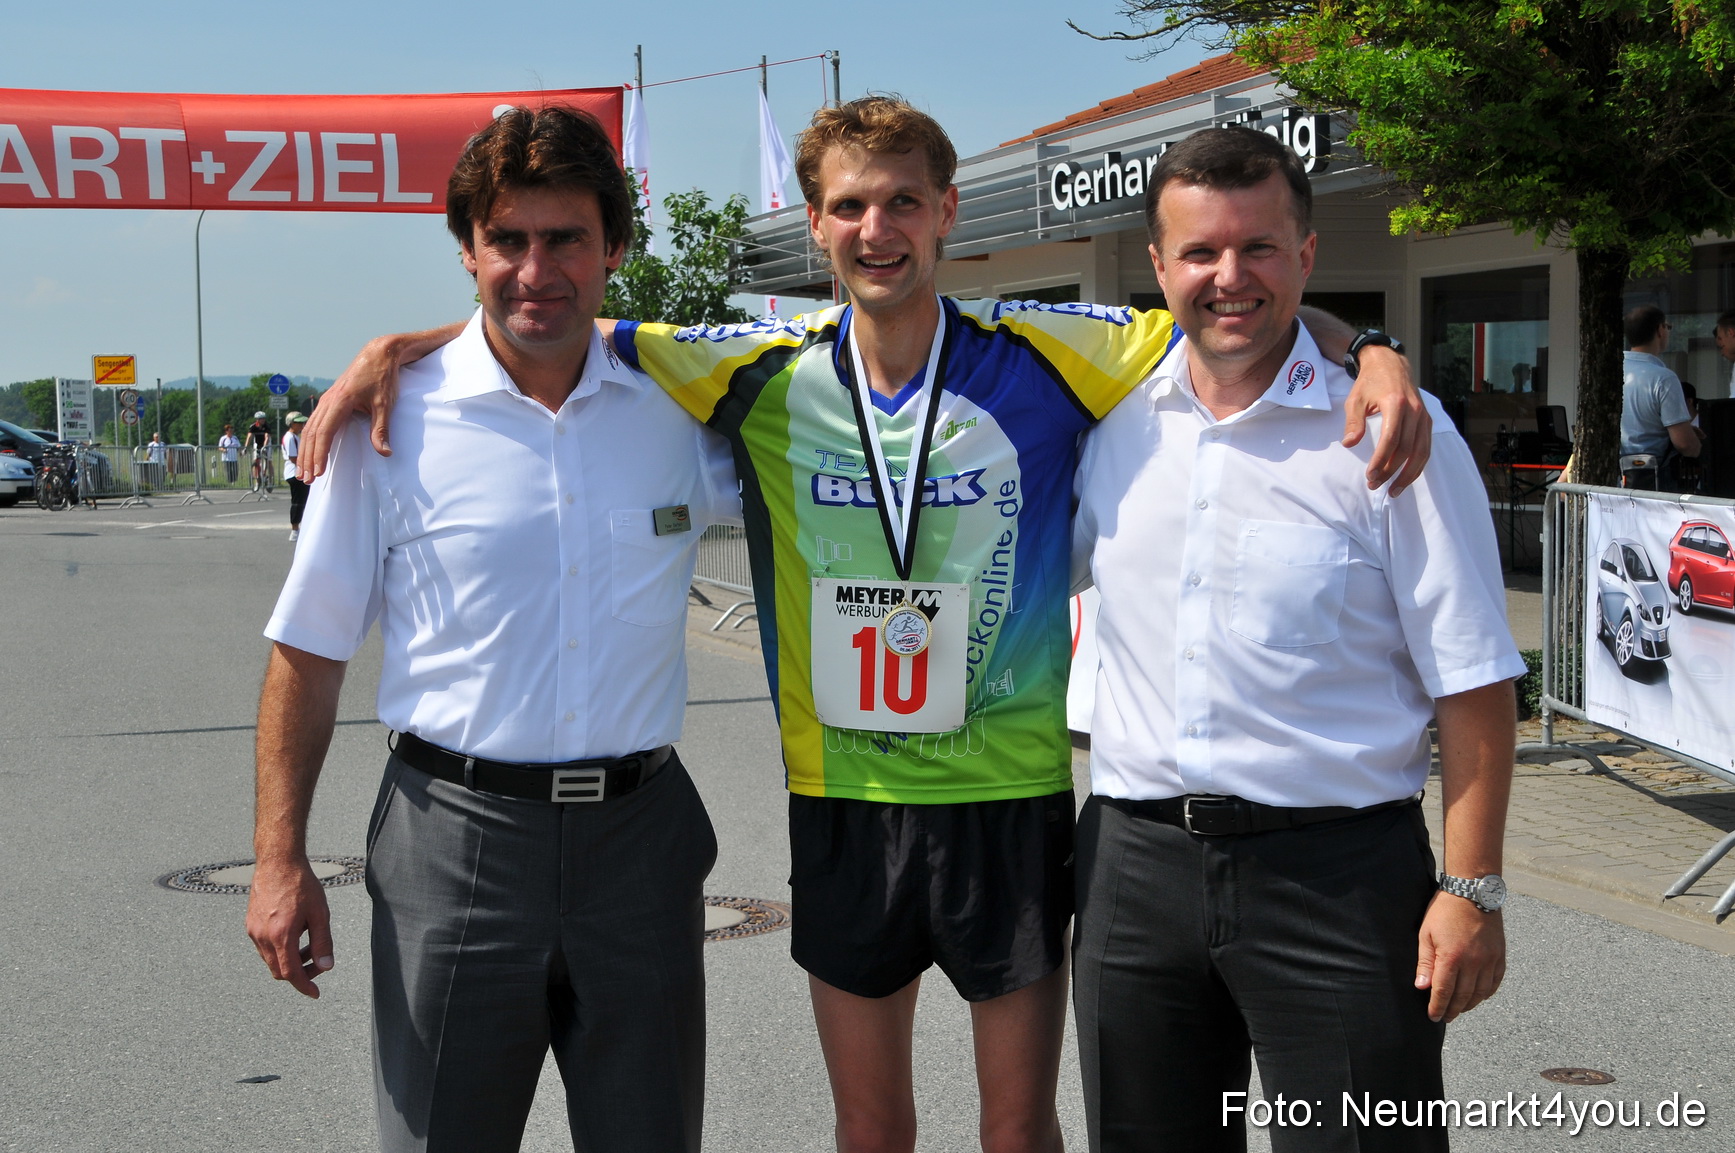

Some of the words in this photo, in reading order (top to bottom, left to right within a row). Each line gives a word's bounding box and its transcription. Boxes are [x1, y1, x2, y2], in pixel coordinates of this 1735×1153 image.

[1050, 141, 1167, 211] Gerhar
[815, 449, 909, 477] TEM
[836, 585, 905, 606] MEYER
[835, 603, 896, 619] WERBUN
[852, 626, 929, 715] 10
